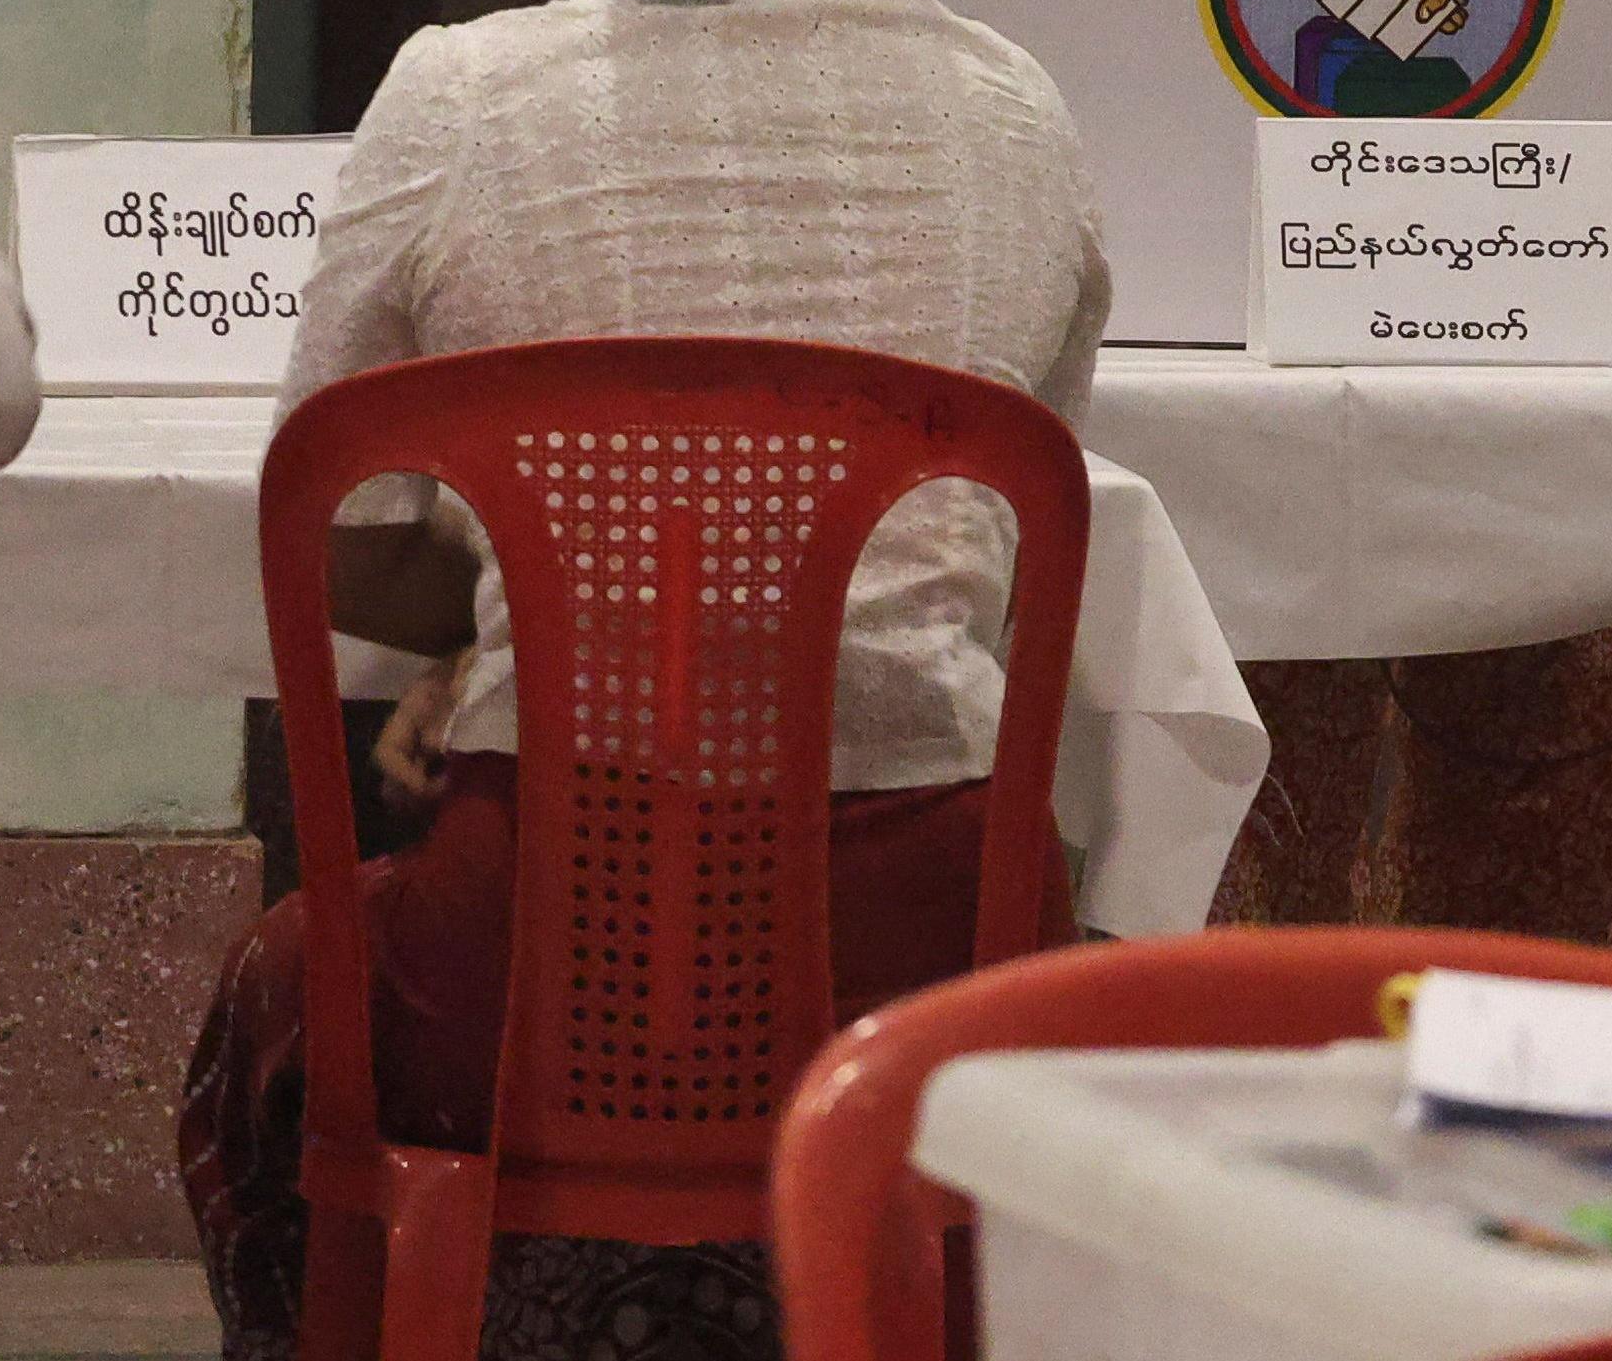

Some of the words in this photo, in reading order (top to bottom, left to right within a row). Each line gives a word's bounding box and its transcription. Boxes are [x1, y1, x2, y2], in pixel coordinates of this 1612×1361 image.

[1310, 140, 1572, 189] တိုင်းဒေသကြီး/
[104, 191, 316, 257] ထိန်းချုပ်စက်
[1280, 222, 1609, 271] ပြည်နယ်လွှတ်တော်
[1370, 308, 1529, 341] မဲပေးစက်
